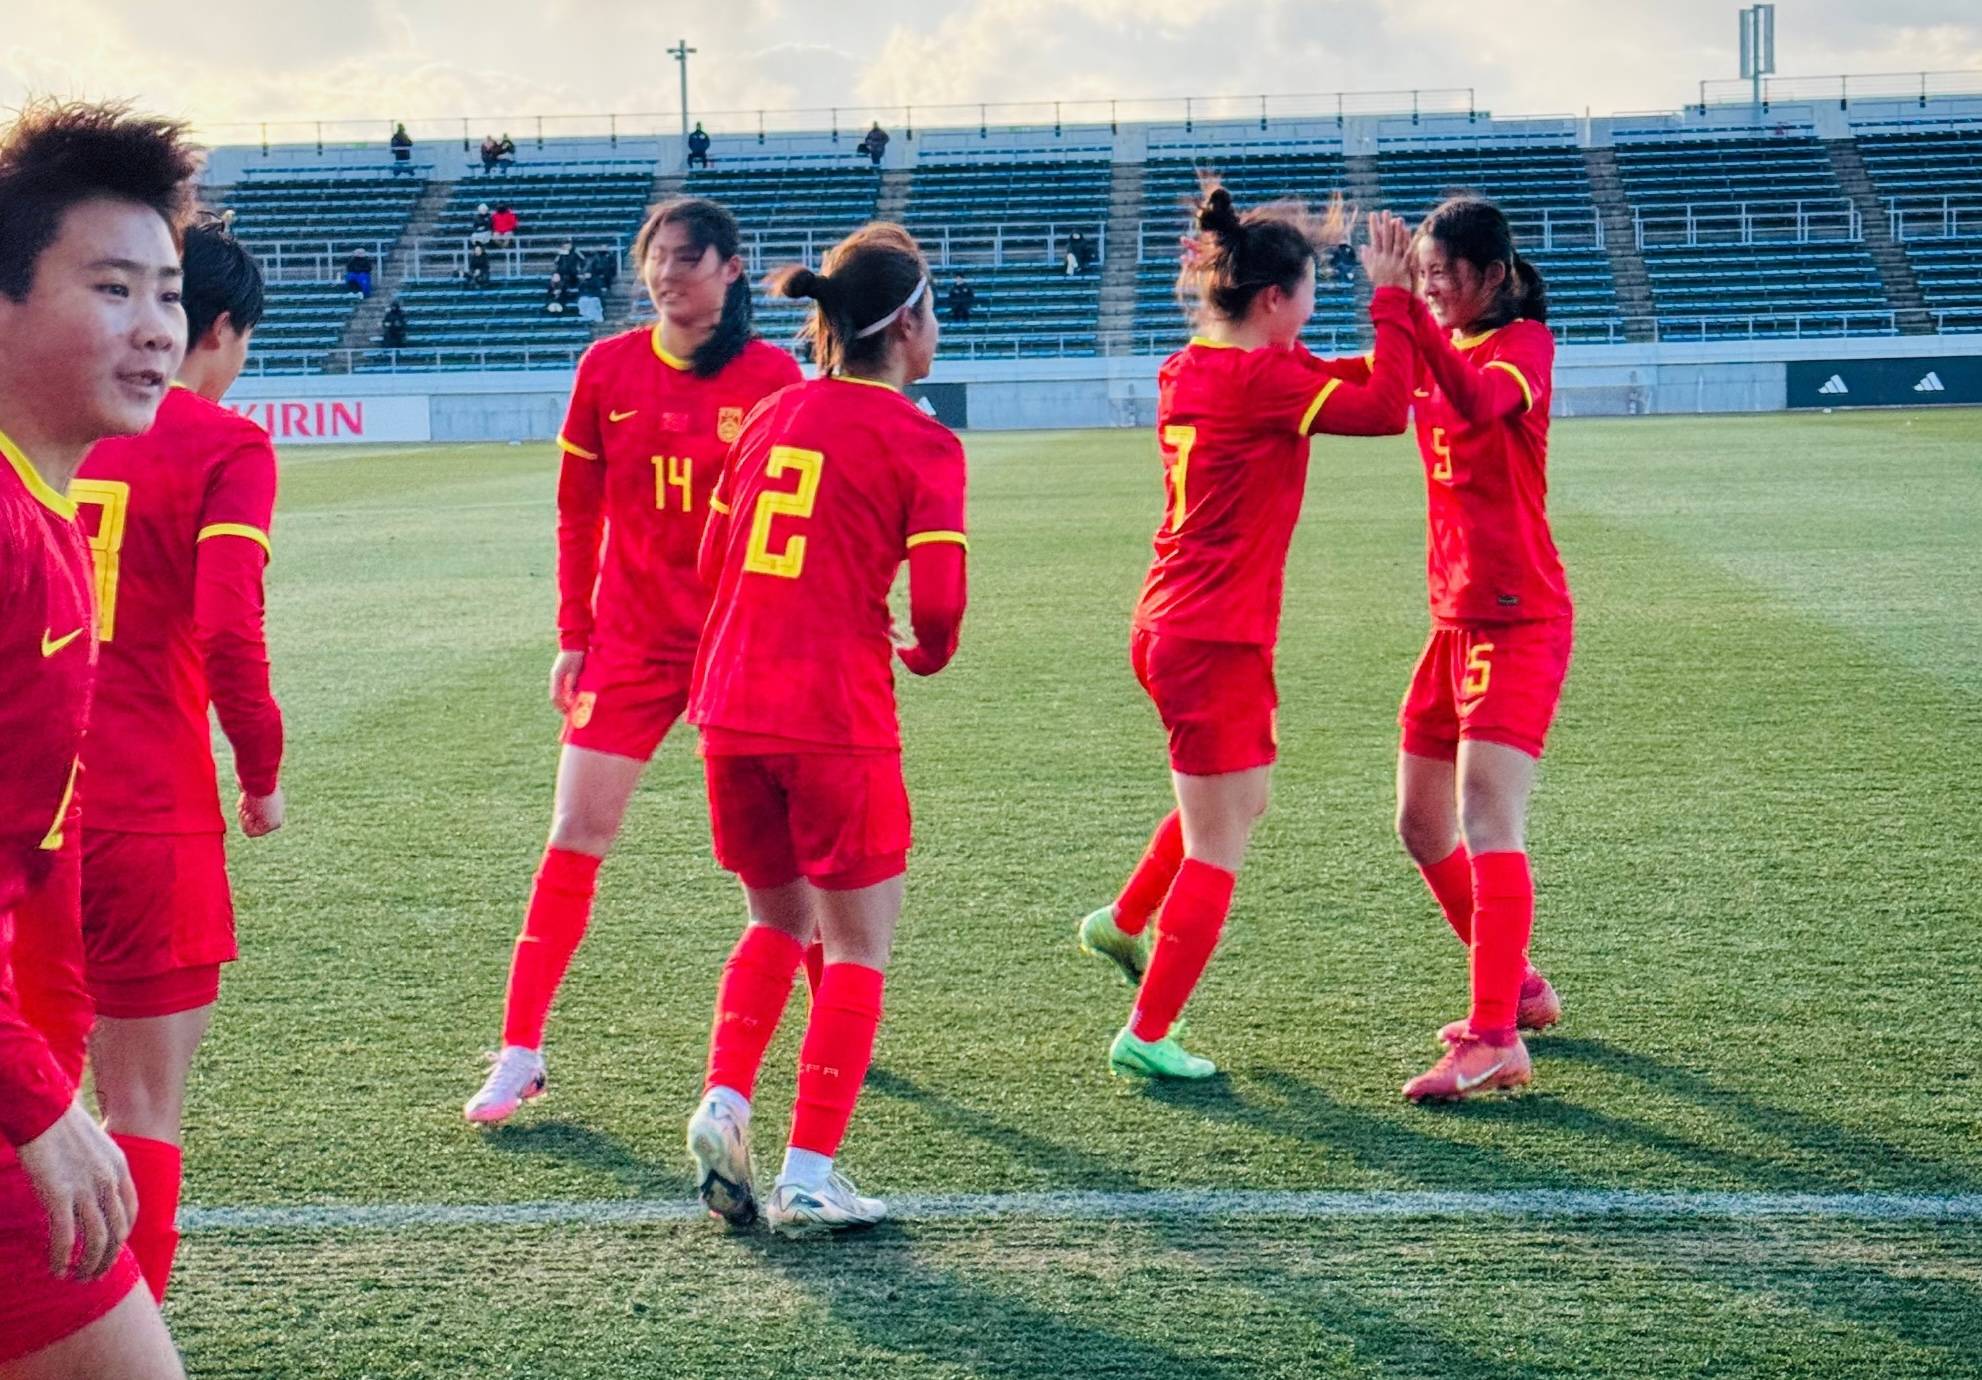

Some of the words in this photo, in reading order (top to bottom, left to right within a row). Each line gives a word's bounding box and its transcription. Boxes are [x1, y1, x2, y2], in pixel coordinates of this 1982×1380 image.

[1163, 425, 1197, 533] 7
[1432, 427, 1453, 480] 5
[651, 455, 693, 512] 14
[744, 445, 824, 579] 2
[1464, 642, 1495, 695] 5
